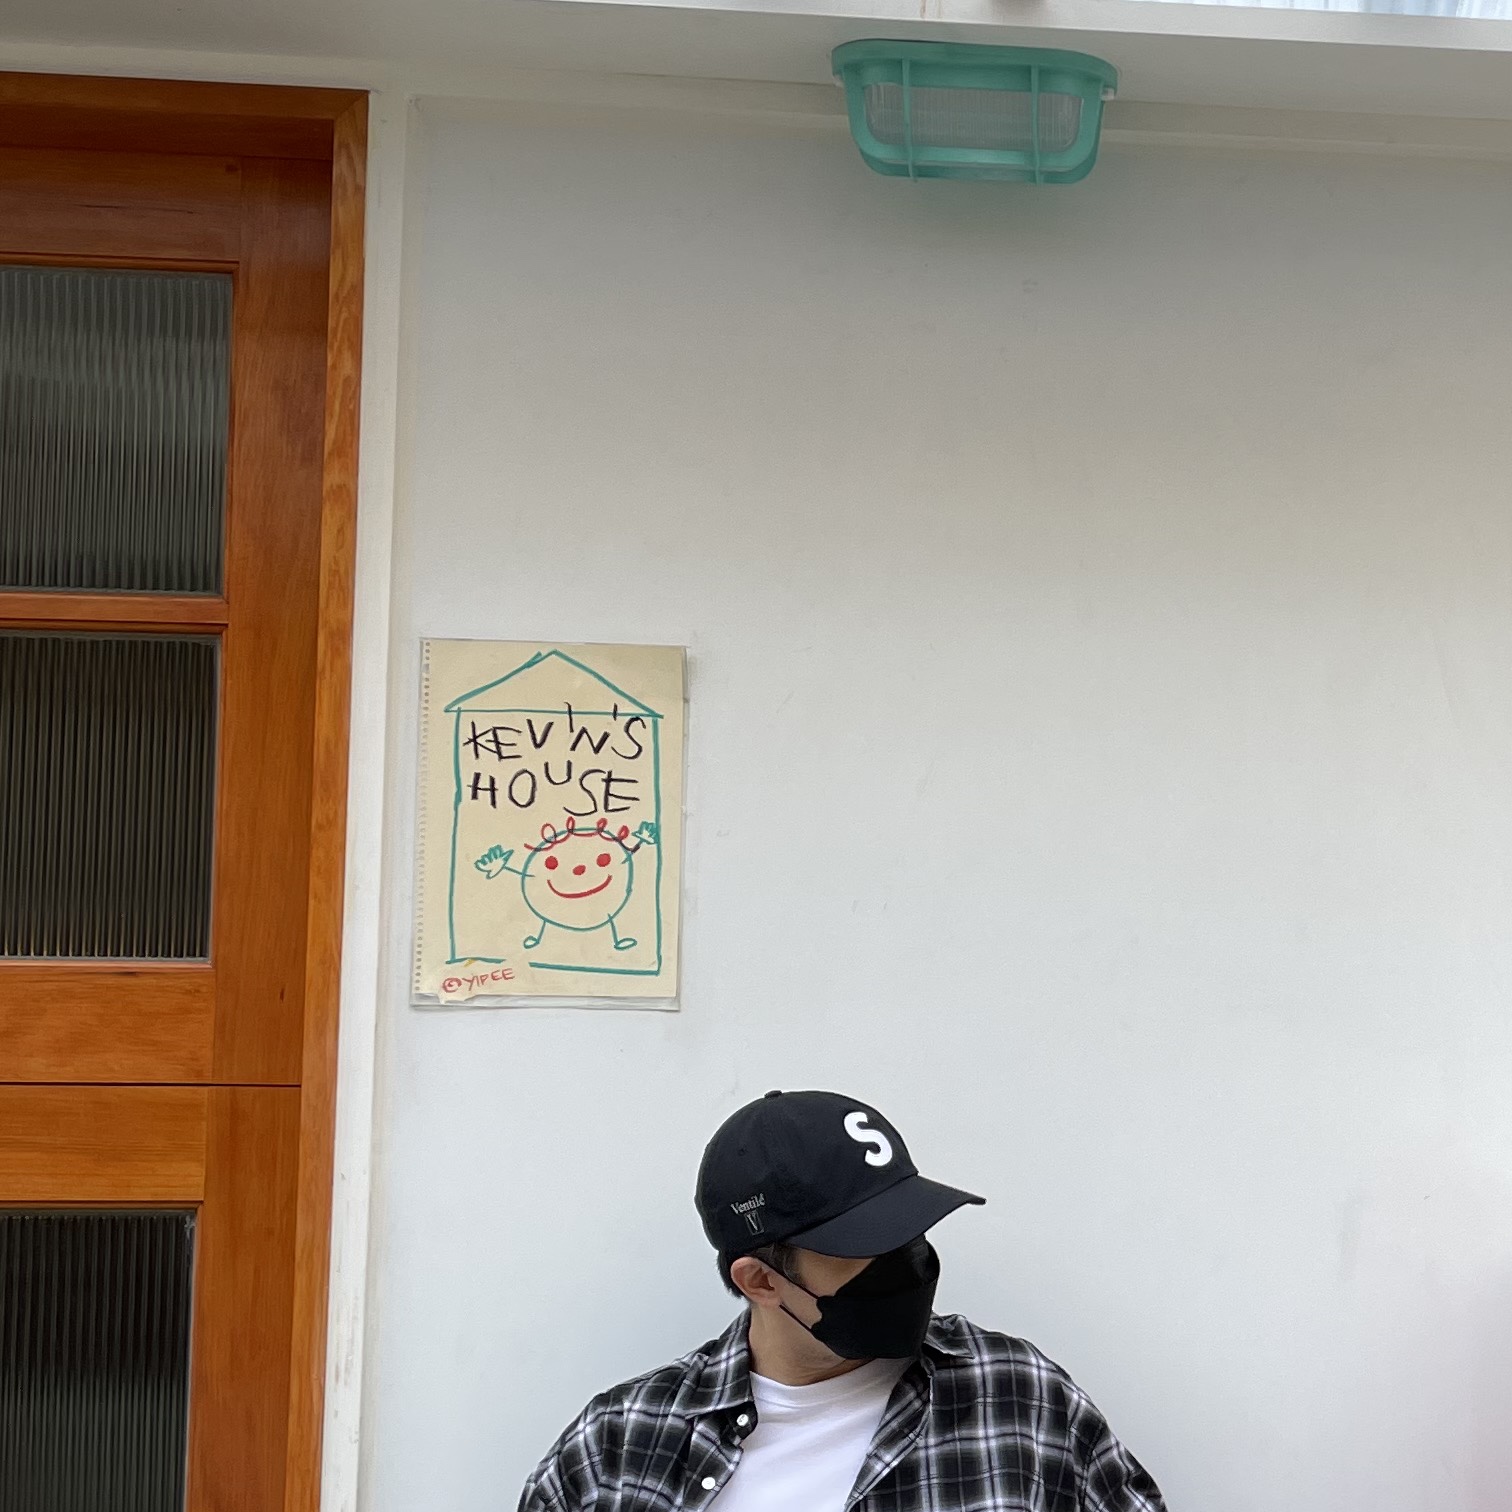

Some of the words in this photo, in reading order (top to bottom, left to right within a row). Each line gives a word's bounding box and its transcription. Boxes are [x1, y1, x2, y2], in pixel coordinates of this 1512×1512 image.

[463, 702, 647, 762] KEVIN'S
[467, 760, 641, 817] HOUSE
[843, 1111, 893, 1167] S
